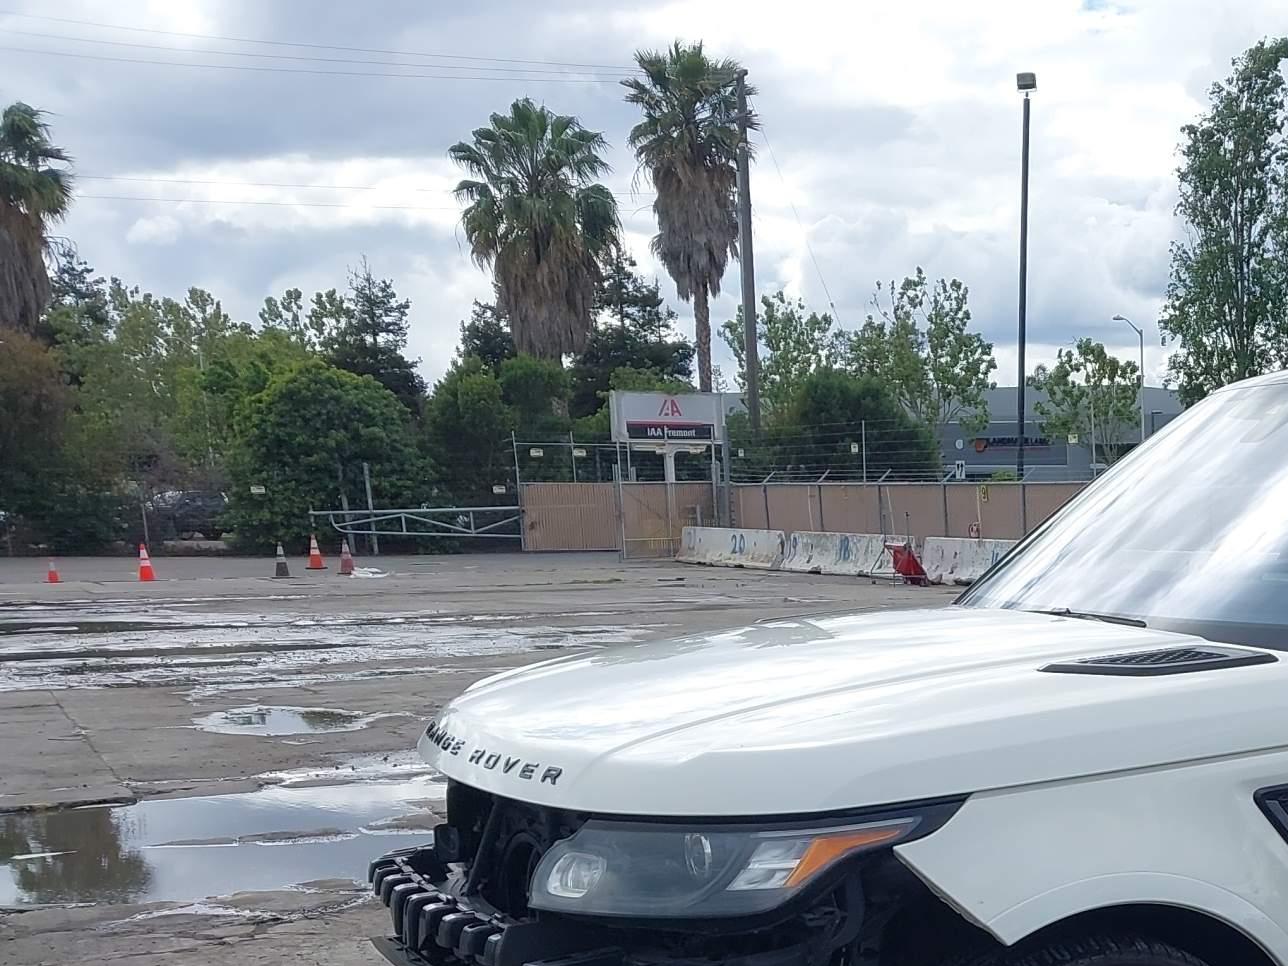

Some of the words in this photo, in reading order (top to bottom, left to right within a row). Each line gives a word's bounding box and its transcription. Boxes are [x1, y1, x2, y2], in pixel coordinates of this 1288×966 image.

[647, 427, 662, 436] IAA
[664, 426, 696, 437] Fremont
[731, 534, 746, 554] 20
[425, 720, 466, 756] RANGE
[468, 749, 563, 785] ROVER
